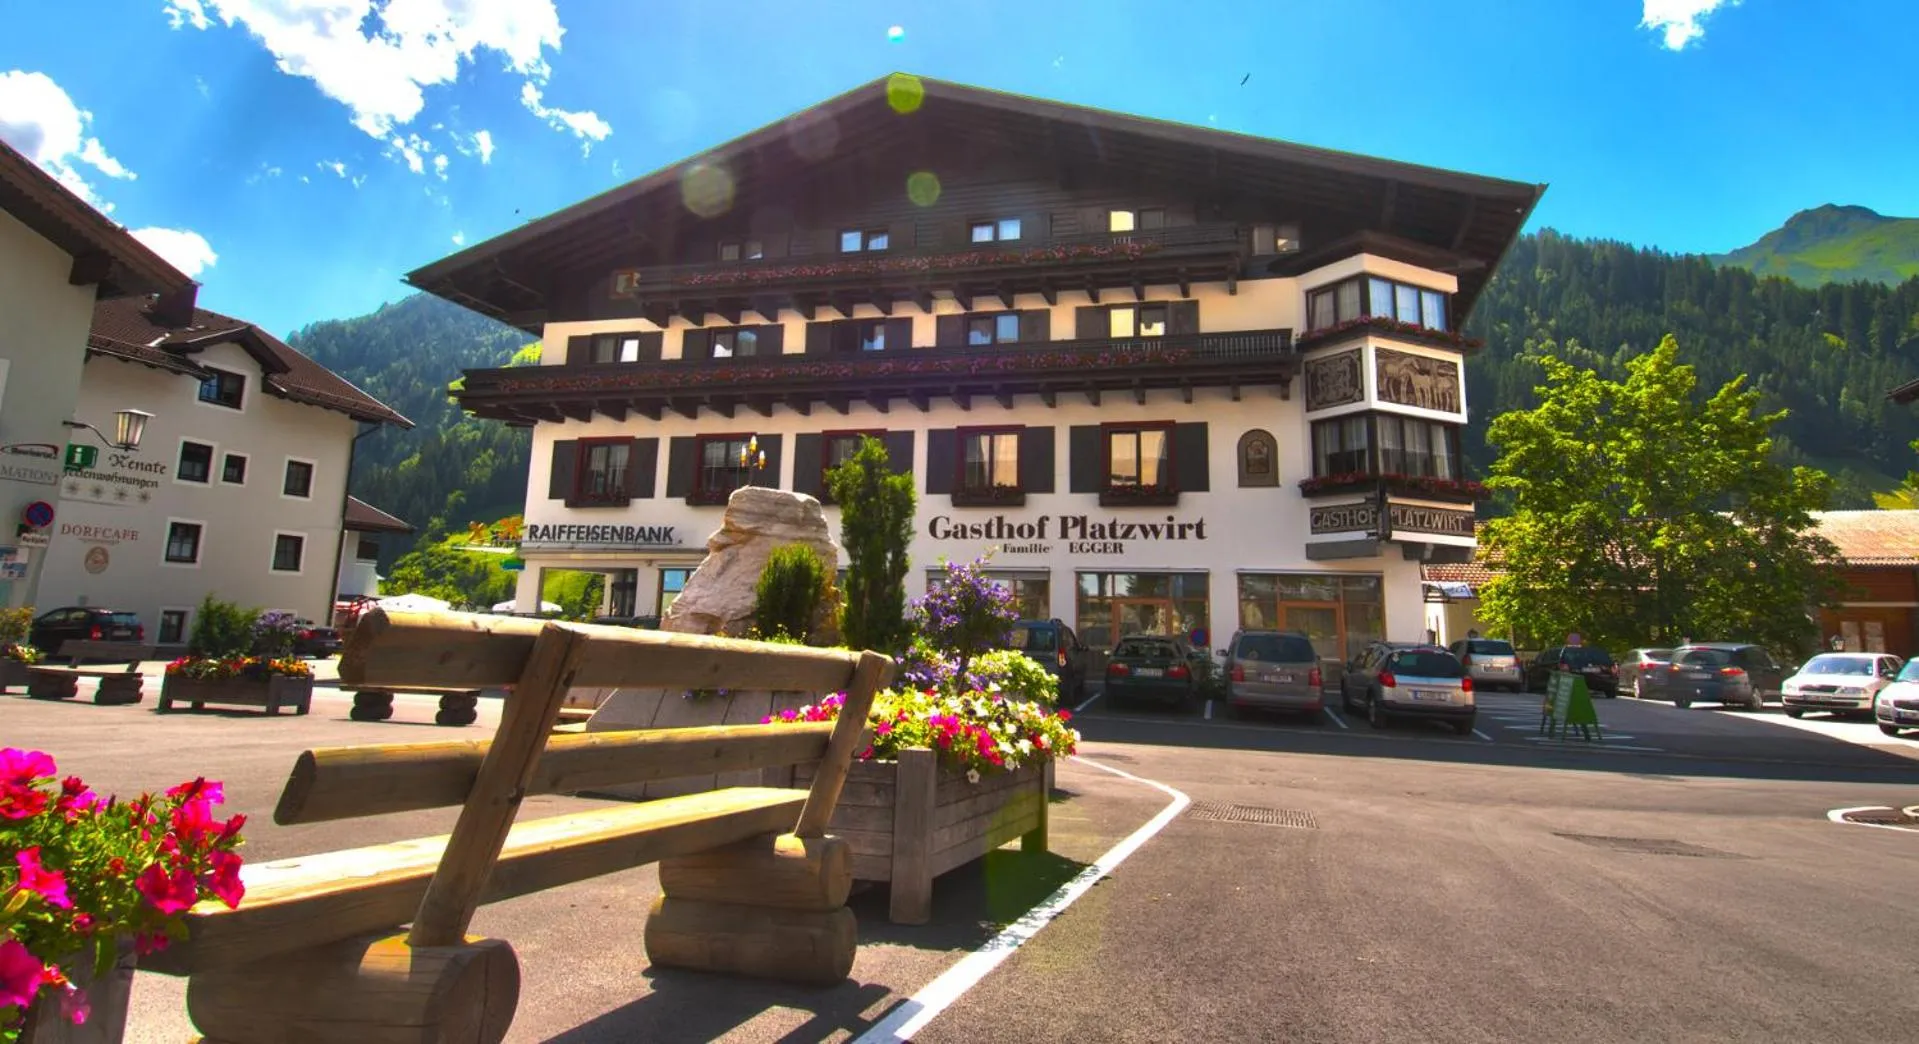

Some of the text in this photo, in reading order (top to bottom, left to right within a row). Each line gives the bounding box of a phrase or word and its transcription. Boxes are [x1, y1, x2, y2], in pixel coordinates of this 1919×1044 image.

[108, 453, 167, 474] Renate
[928, 515, 1207, 540] Gasthof Platzwirt
[1311, 508, 1466, 532] GASTHOF PLATZWIRT
[61, 523, 141, 541] DORFCAFE
[528, 524, 675, 543] RAIFFEISENBANK
[1003, 542, 1124, 554] Familie EGGER
